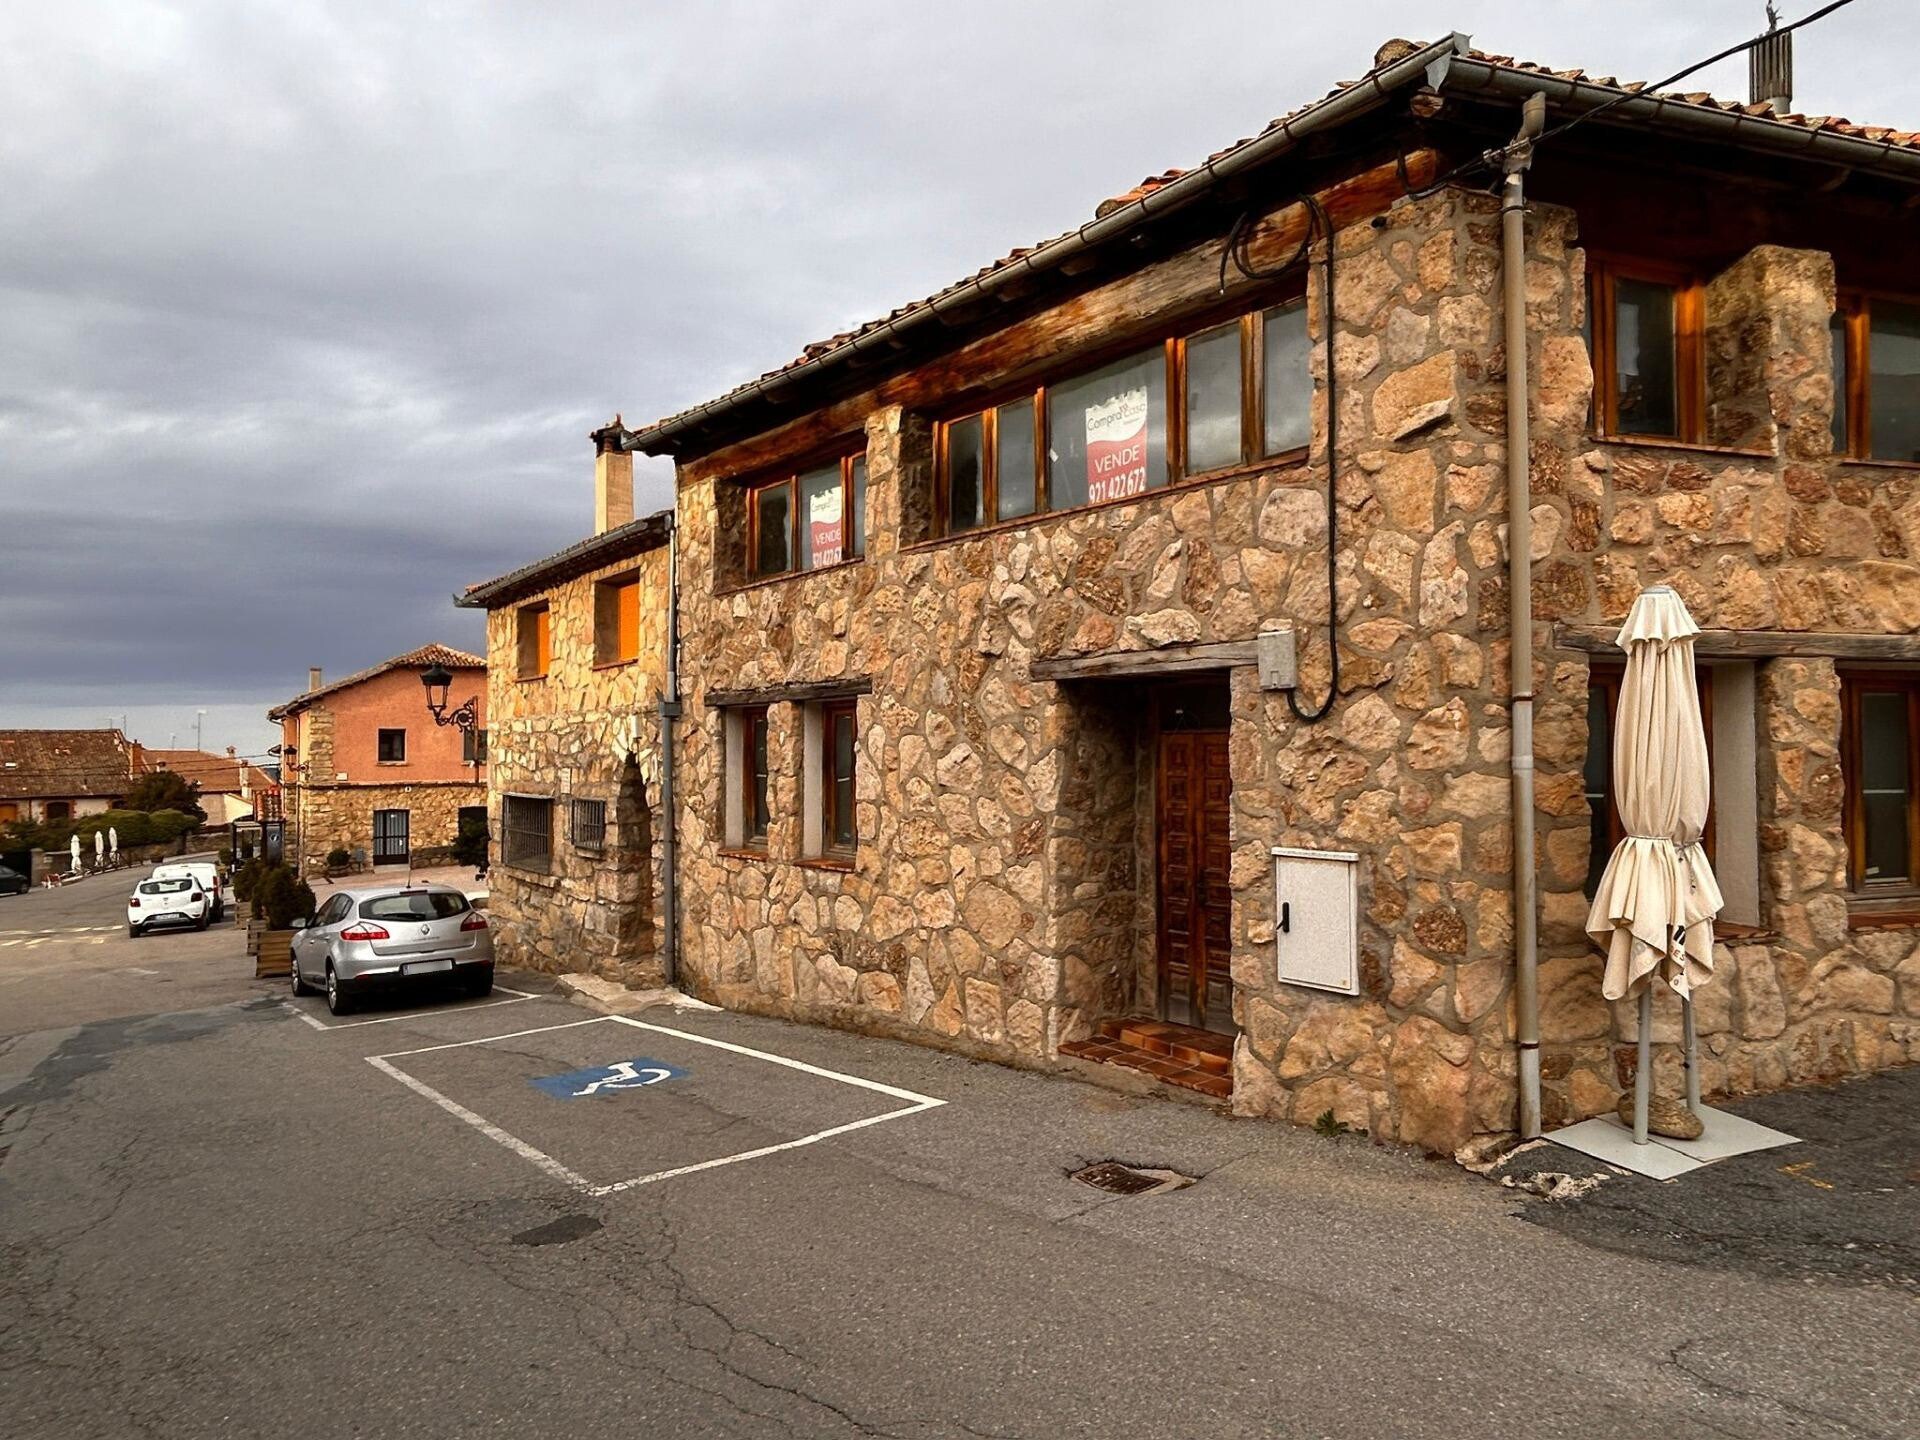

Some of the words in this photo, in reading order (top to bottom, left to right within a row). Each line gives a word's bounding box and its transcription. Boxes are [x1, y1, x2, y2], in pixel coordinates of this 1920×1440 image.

[1094, 444, 1140, 473] VENDE
[1089, 474, 1106, 505] 921
[1107, 472, 1127, 500] 422
[1127, 466, 1145, 496] 672
